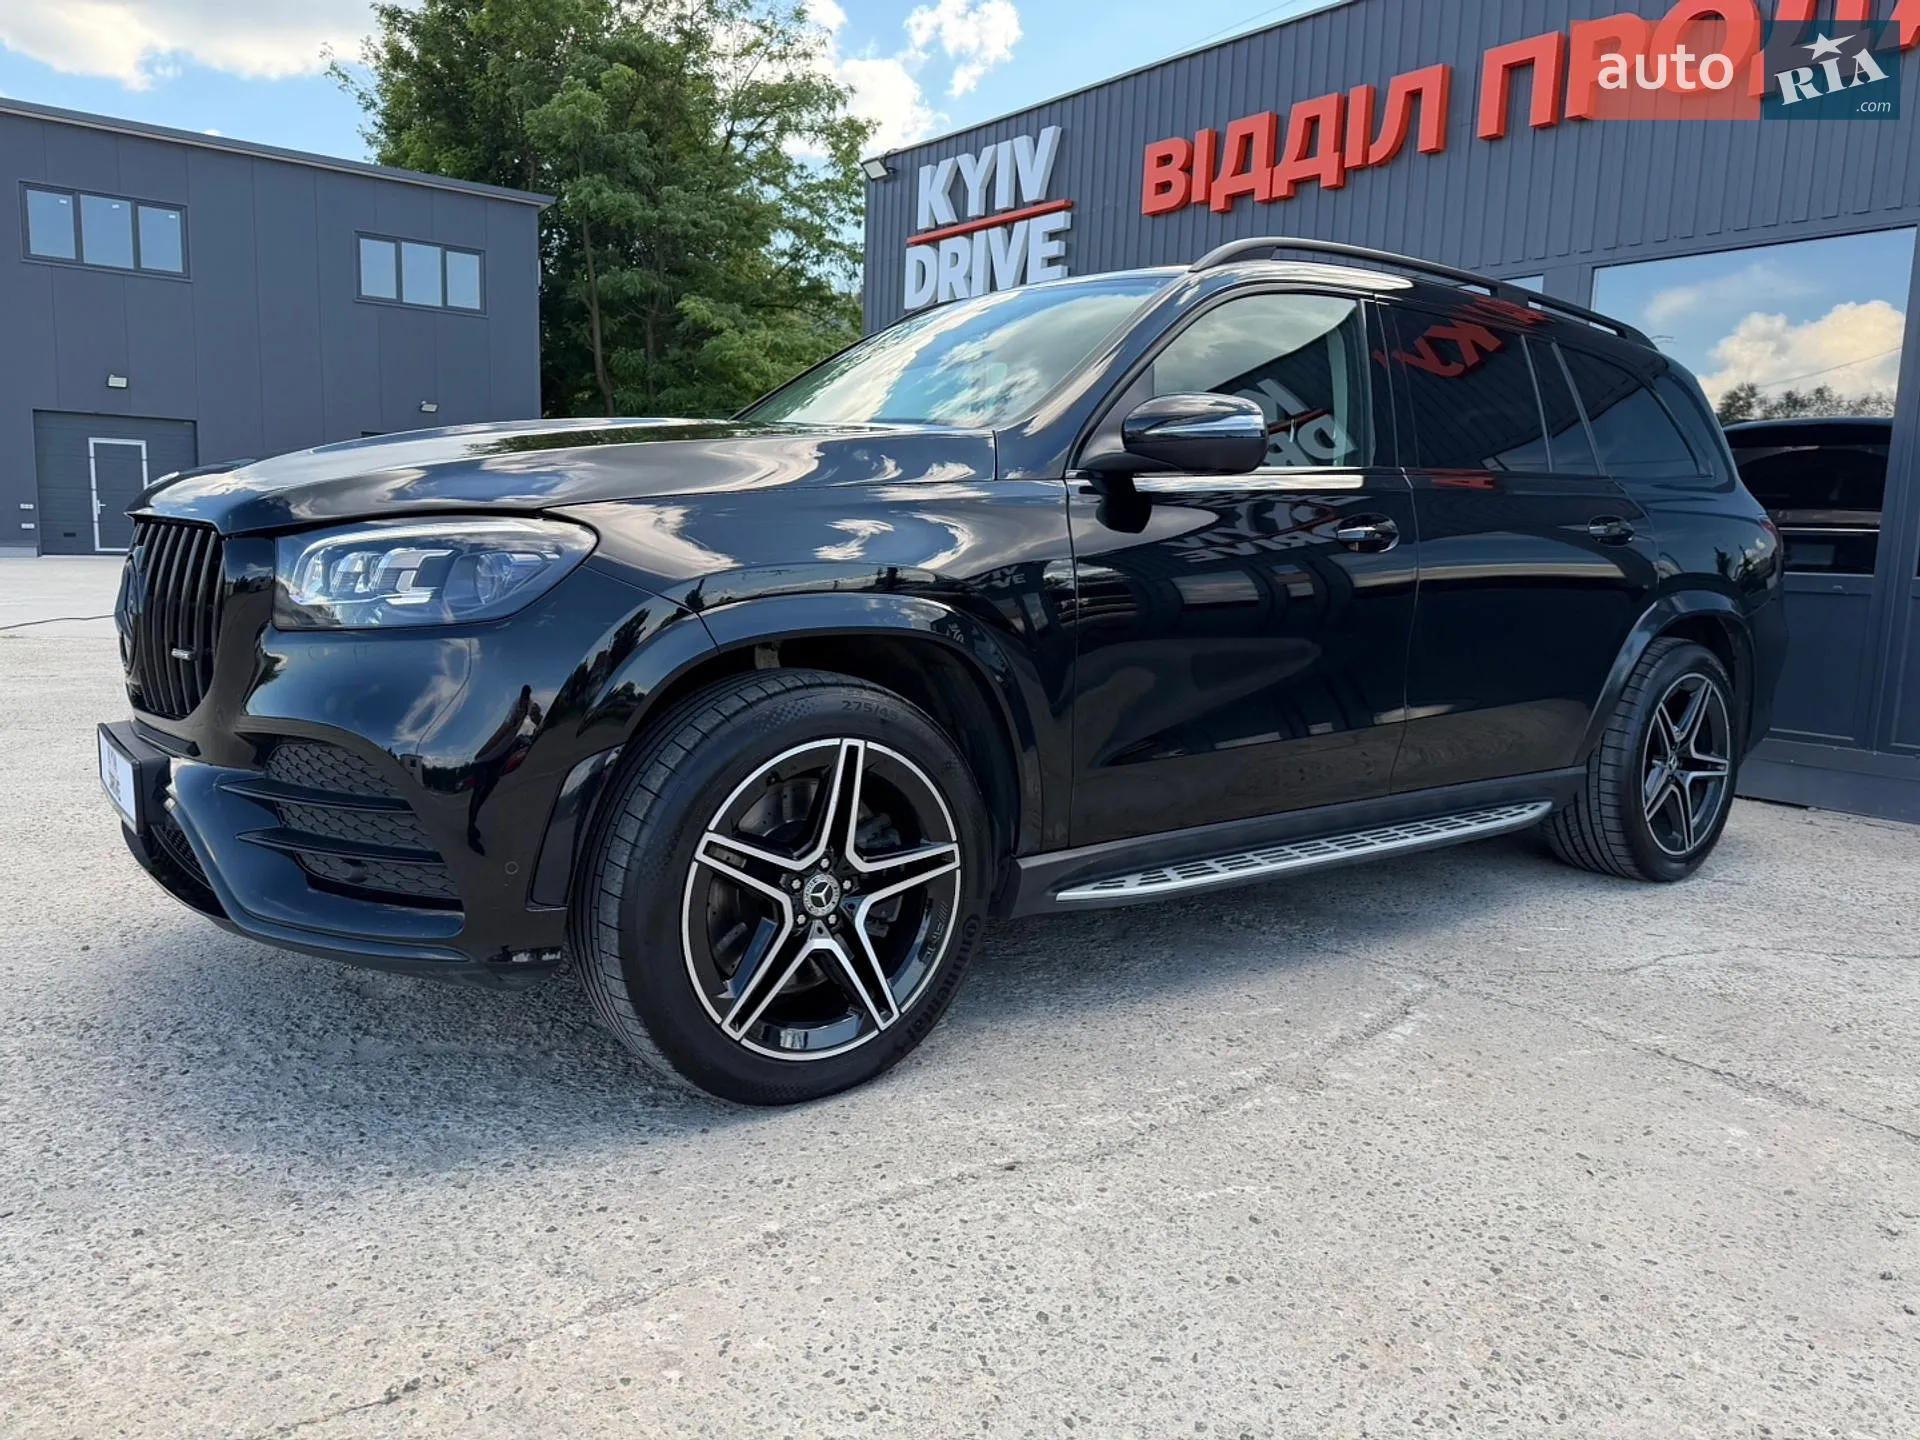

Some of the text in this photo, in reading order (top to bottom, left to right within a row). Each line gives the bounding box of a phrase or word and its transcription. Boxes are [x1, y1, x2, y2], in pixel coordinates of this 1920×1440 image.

[917, 125, 1062, 230] KYIV
[1142, 63, 1450, 216] ВІДДІЛ
[904, 211, 1072, 310] DRIVE
